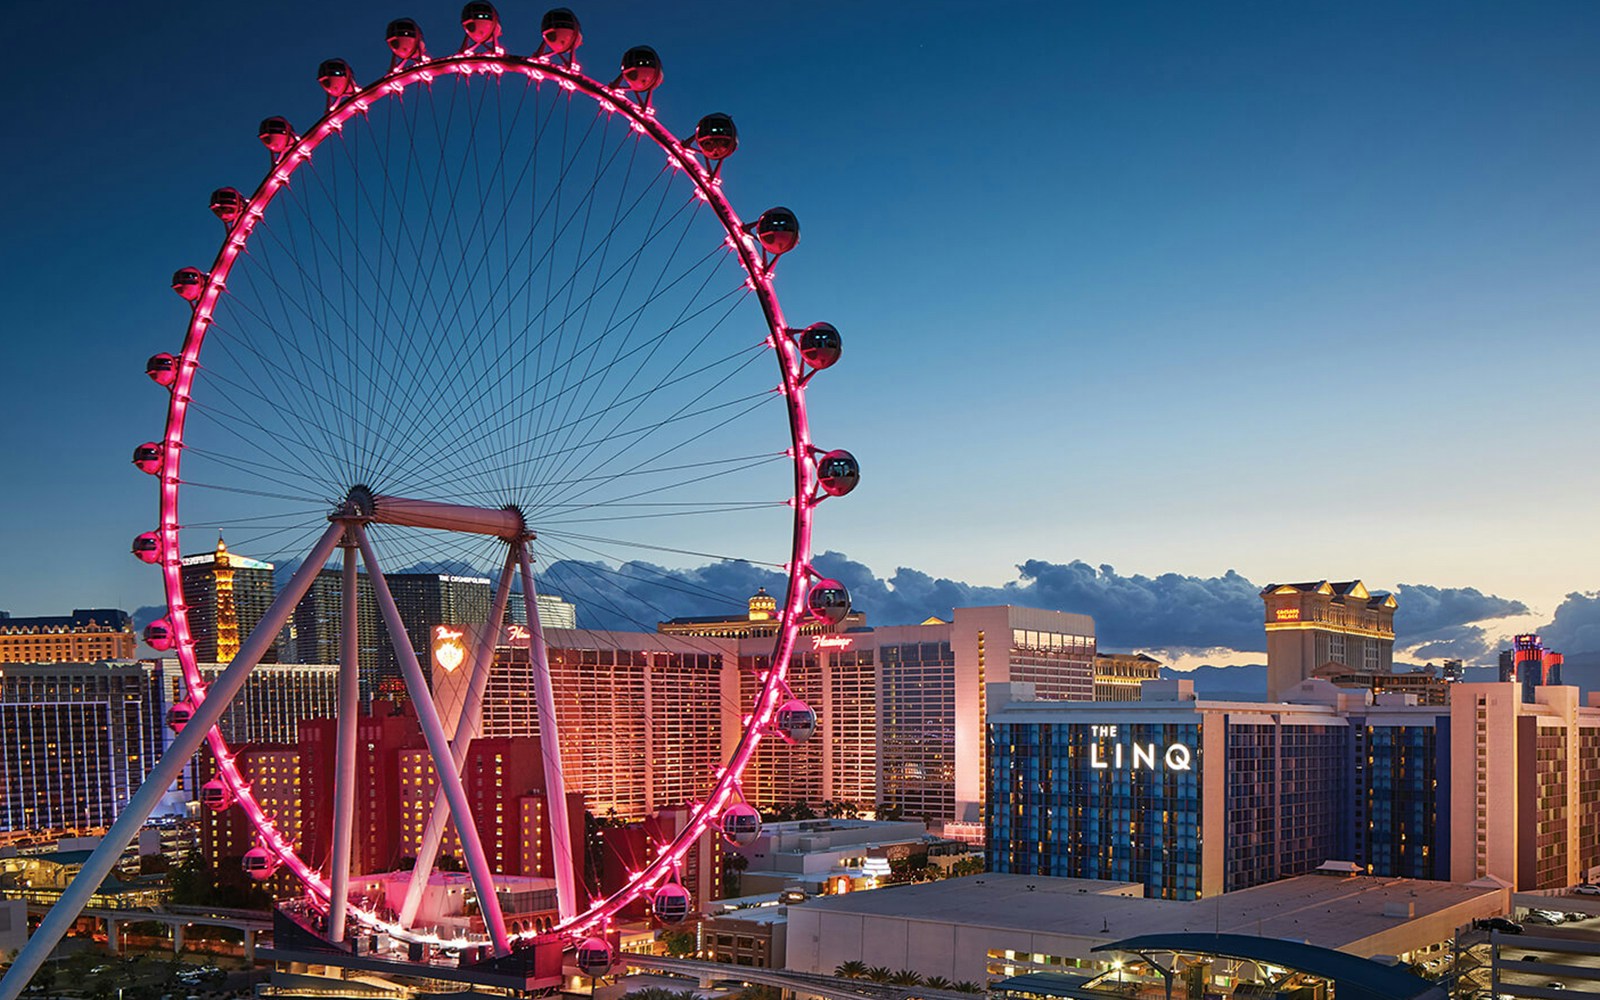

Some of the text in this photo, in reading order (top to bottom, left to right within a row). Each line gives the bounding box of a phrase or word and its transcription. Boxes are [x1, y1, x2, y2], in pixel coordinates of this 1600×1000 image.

[812, 635, 853, 650] Flamingo
[1091, 725, 1117, 737] THE
[1091, 742, 1191, 771] LINQ
